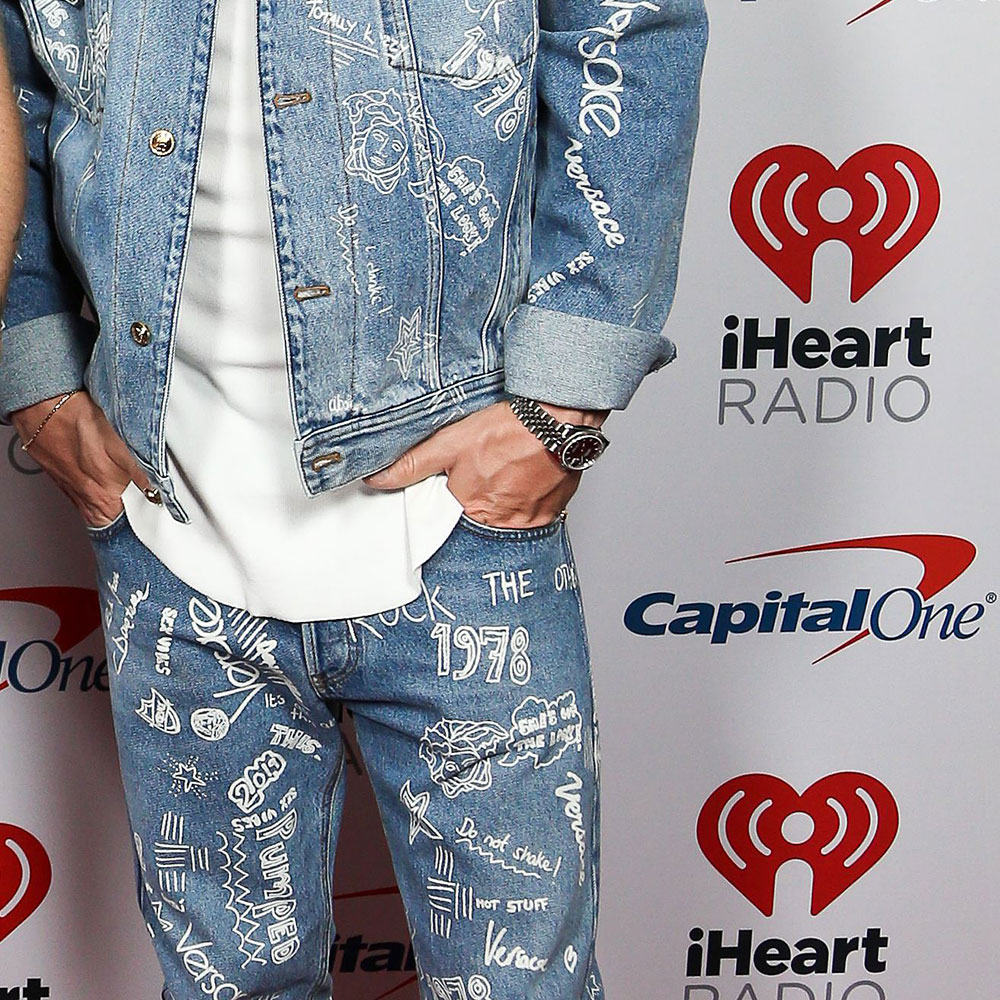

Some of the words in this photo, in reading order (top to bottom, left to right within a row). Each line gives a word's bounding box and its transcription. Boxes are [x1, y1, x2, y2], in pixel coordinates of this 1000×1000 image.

[722, 315, 933, 370] iHeart
[719, 375, 931, 426] RADIO
[483, 569, 534, 606] THE
[430, 622, 532, 686] 1978
[456, 817, 476, 839] Do
[475, 898, 501, 911] HOT
[686, 927, 889, 978] iHeart
